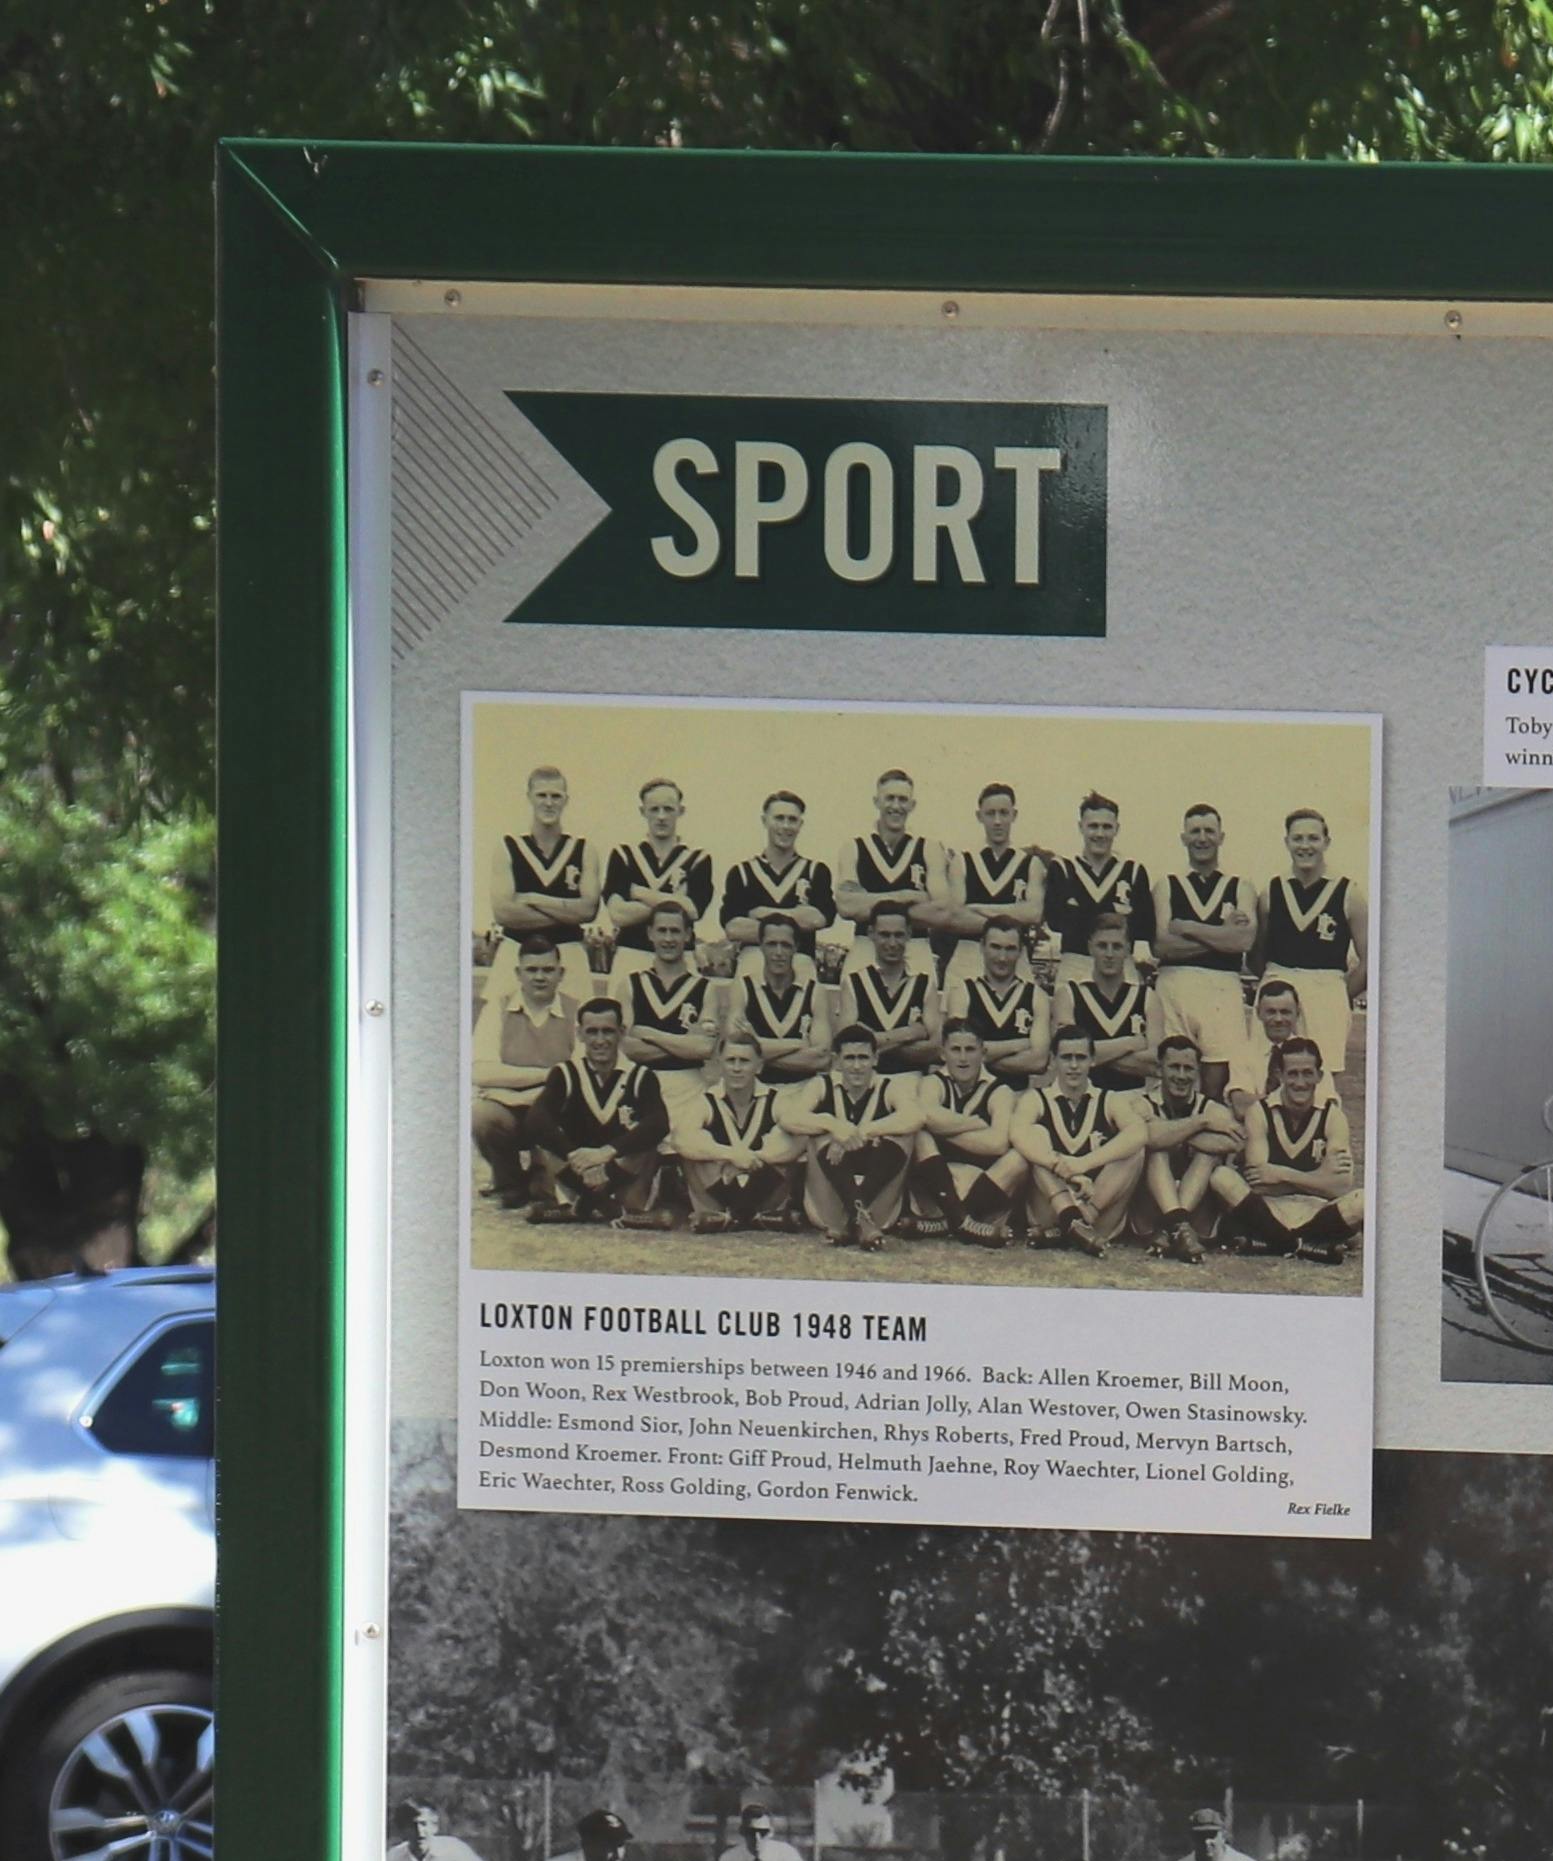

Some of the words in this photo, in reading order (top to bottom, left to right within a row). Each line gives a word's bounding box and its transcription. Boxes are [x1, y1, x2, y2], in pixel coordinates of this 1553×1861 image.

[650, 436, 1062, 587] SPORT
[1504, 715, 1553, 740] Toby
[479, 1302, 572, 1331] LOXTON
[583, 1305, 707, 1336] FOOTBALL
[717, 1309, 781, 1337] CLUB
[792, 1311, 852, 1340] 1948
[861, 1314, 927, 1342] TEAM
[479, 1349, 545, 1369] Loxton
[549, 1356, 591, 1371] won
[596, 1353, 616, 1372] 15
[619, 1355, 745, 1381] premierships
[749, 1357, 829, 1378] between
[835, 1361, 877, 1380] 1946
[881, 1362, 918, 1381] and
[924, 1364, 972, 1383] 1966.
[981, 1365, 1033, 1385] Back:
[1037, 1367, 1091, 1387] Allen
[1095, 1369, 1184, 1392] Kroemer,
[1189, 1371, 1222, 1391] Bill
[1227, 1373, 1289, 1395] Moon,
[479, 1379, 520, 1399] Don
[524, 1380, 587, 1403] Woon,
[591, 1383, 628, 1402] Rex
[631, 1384, 740, 1408] Westbrook,
[744, 1388, 782, 1407] Bob
[787, 1389, 849, 1412] Proud,
[853, 1391, 921, 1412] Adrian
[925, 1393, 972, 1419] Jolly,
[976, 1395, 1023, 1415] Alan
[1027, 1397, 1120, 1421] Westover,
[1125, 1400, 1181, 1420] Owen
[1186, 1402, 1308, 1429] Stasinowsky.
[478, 1409, 552, 1430] Middle:
[557, 1412, 635, 1433] Esmond
[639, 1415, 683, 1436] Sior,
[687, 1416, 733, 1438] John
[737, 1418, 878, 1443] Neuenkirchen,
[883, 1422, 930, 1447] Rhys
[935, 1424, 1015, 1447] Roberts,
[1019, 1427, 1062, 1447] Fred
[1067, 1429, 1130, 1451] Proud,
[1135, 1431, 1209, 1455] Mervyn
[1215, 1433, 1293, 1456] Bartsch,
[478, 1470, 517, 1489] Eric
[521, 1471, 616, 1494] Waechter,
[621, 1474, 665, 1494] Ross
[669, 1476, 752, 1502] Golding,
[756, 1479, 830, 1500] Gordon
[834, 1481, 918, 1503] Fenwick.
[479, 1439, 570, 1461] Desmond
[575, 1443, 662, 1464] Kroemer.
[667, 1446, 724, 1466] Front:
[728, 1448, 768, 1467] Giff
[770, 1449, 832, 1472] Proud,
[837, 1451, 922, 1473] Helmuth
[927, 1454, 998, 1477] Jaehne,
[1003, 1457, 1041, 1481] Roy
[1044, 1458, 1140, 1482] Waechter,
[1145, 1461, 1206, 1482] Lionel
[1211, 1463, 1294, 1489] Golding,
[1286, 1501, 1311, 1515] Rex
[1313, 1502, 1351, 1517] Fielke
